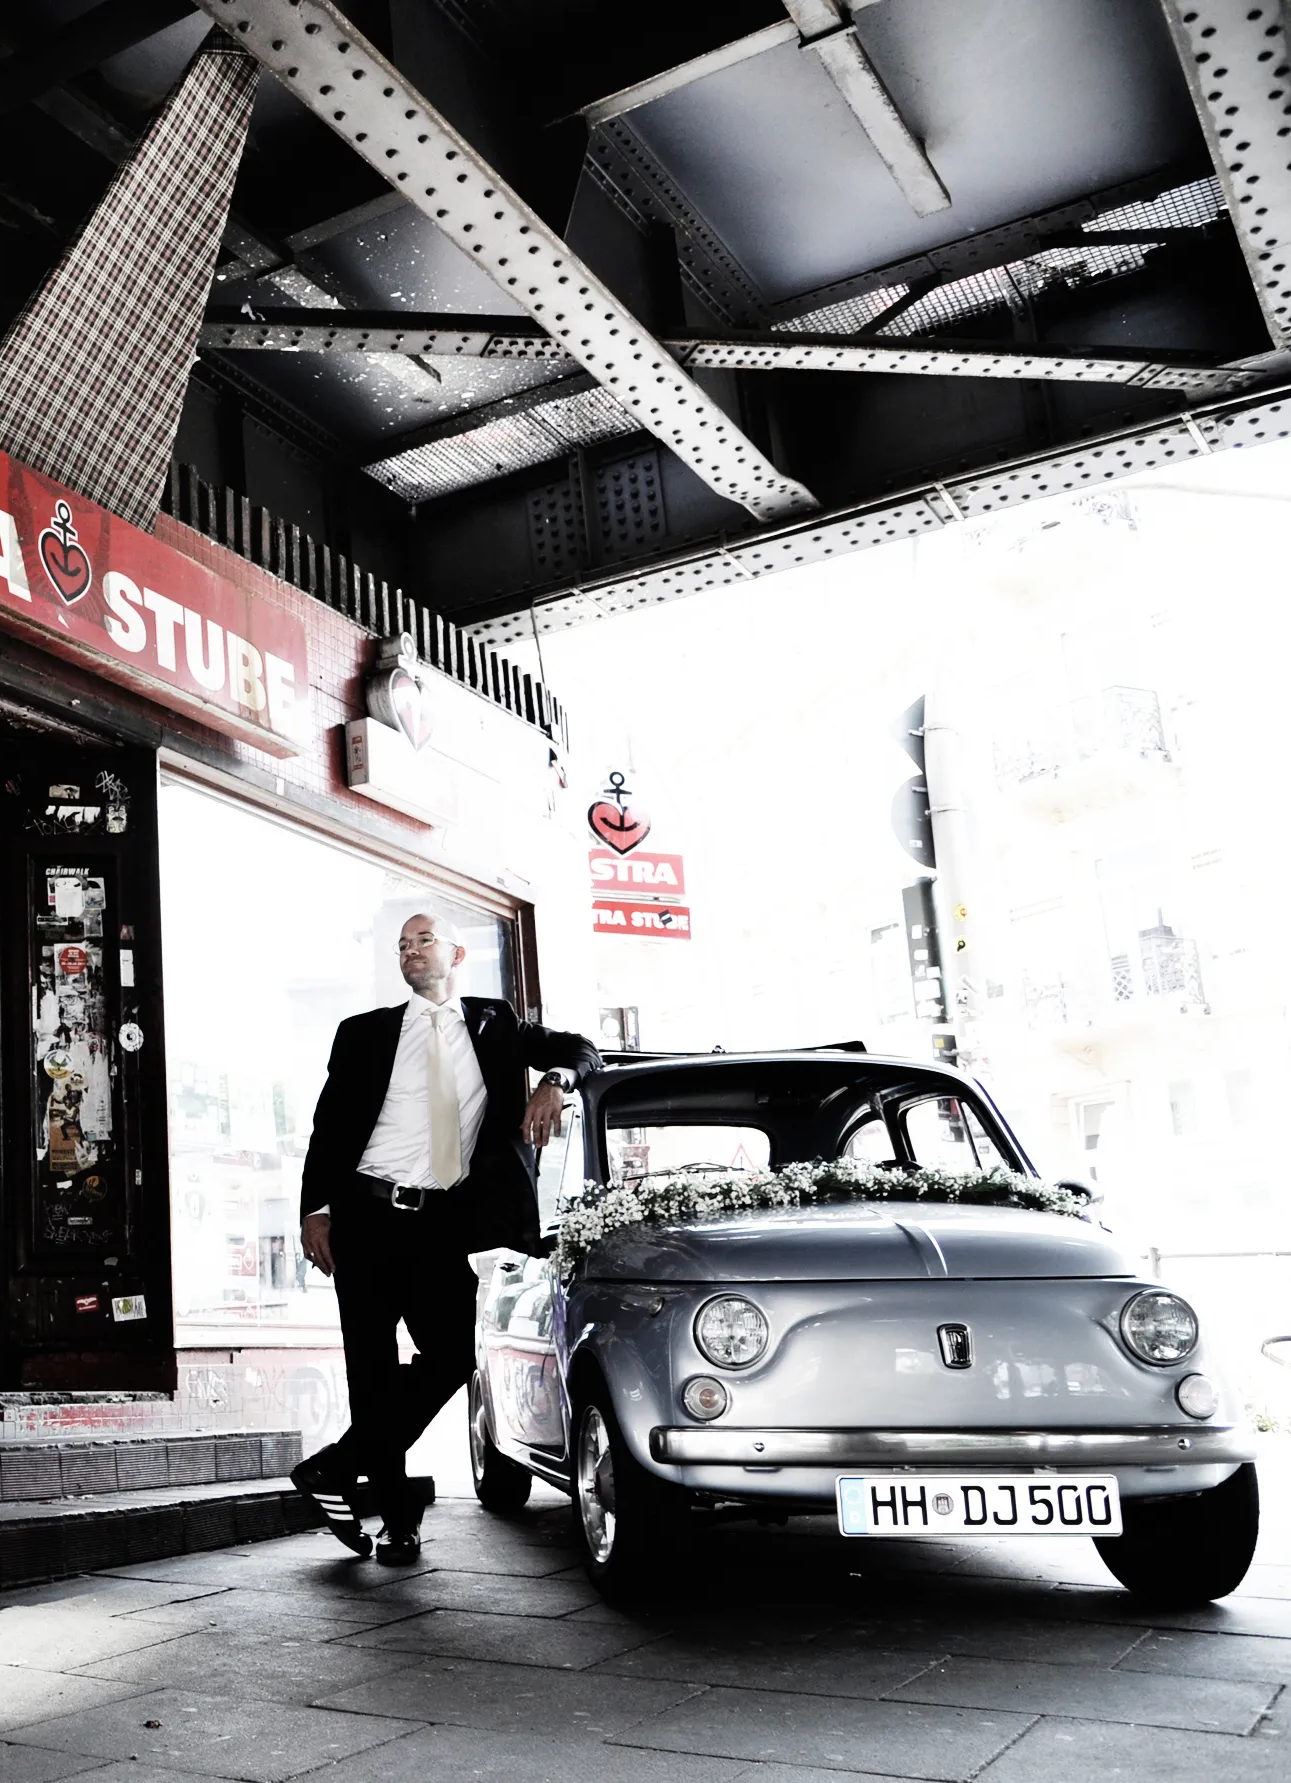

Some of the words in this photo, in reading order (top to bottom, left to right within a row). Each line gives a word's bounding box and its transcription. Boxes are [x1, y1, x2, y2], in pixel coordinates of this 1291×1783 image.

[102, 571, 297, 737] STUBE
[45, 867, 90, 876] CHAIRWALK
[591, 858, 679, 886] STRA
[870, 1485, 929, 1526] HH
[960, 1485, 1018, 1526] DJ
[1029, 1485, 1112, 1526] 500
